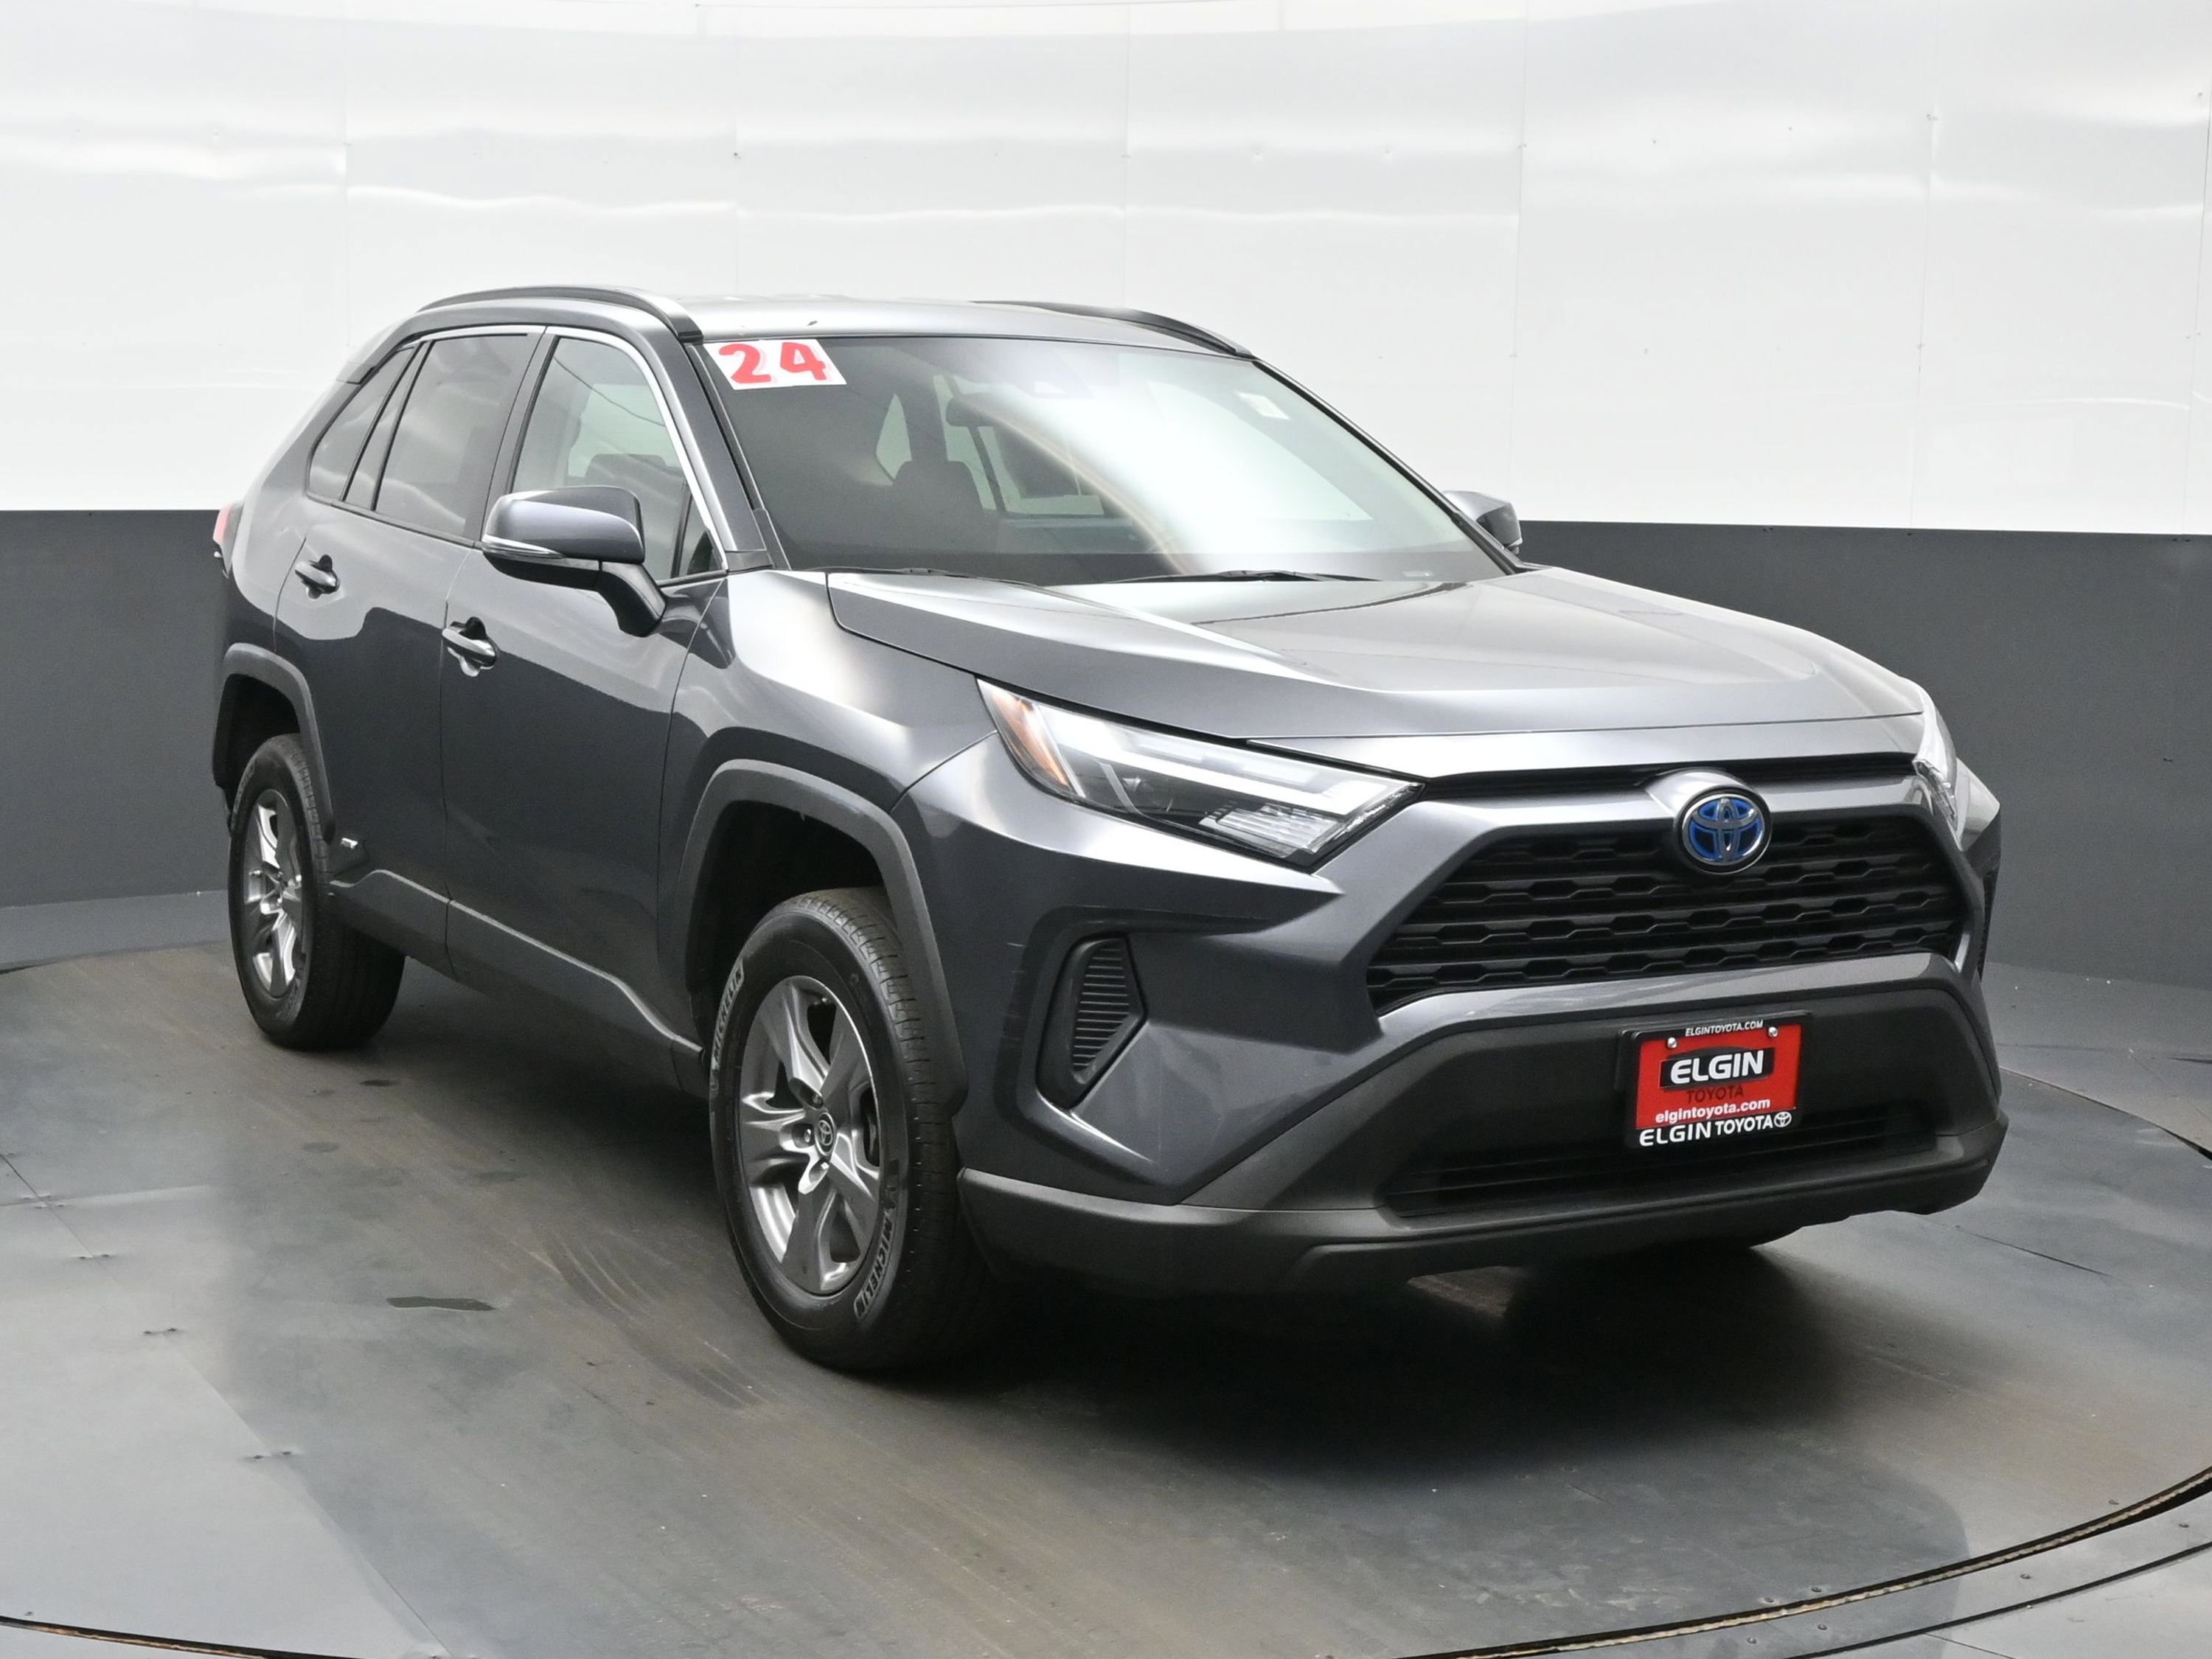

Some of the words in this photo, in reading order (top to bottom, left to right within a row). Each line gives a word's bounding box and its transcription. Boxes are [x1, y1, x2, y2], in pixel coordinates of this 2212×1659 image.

[719, 342, 828, 384] 24
[1685, 1019, 1764, 1037] ELGINTOYOTA.COM
[1670, 1050, 1764, 1084] ELGIN
[1655, 1099, 1771, 1124] elgintoyota.com
[1686, 1085, 1745, 1104] TOYOTA
[1639, 1121, 1712, 1147] ELGIN
[1714, 1113, 1773, 1135] TOYOTA
[855, 1216, 894, 1318] MICHELIN
